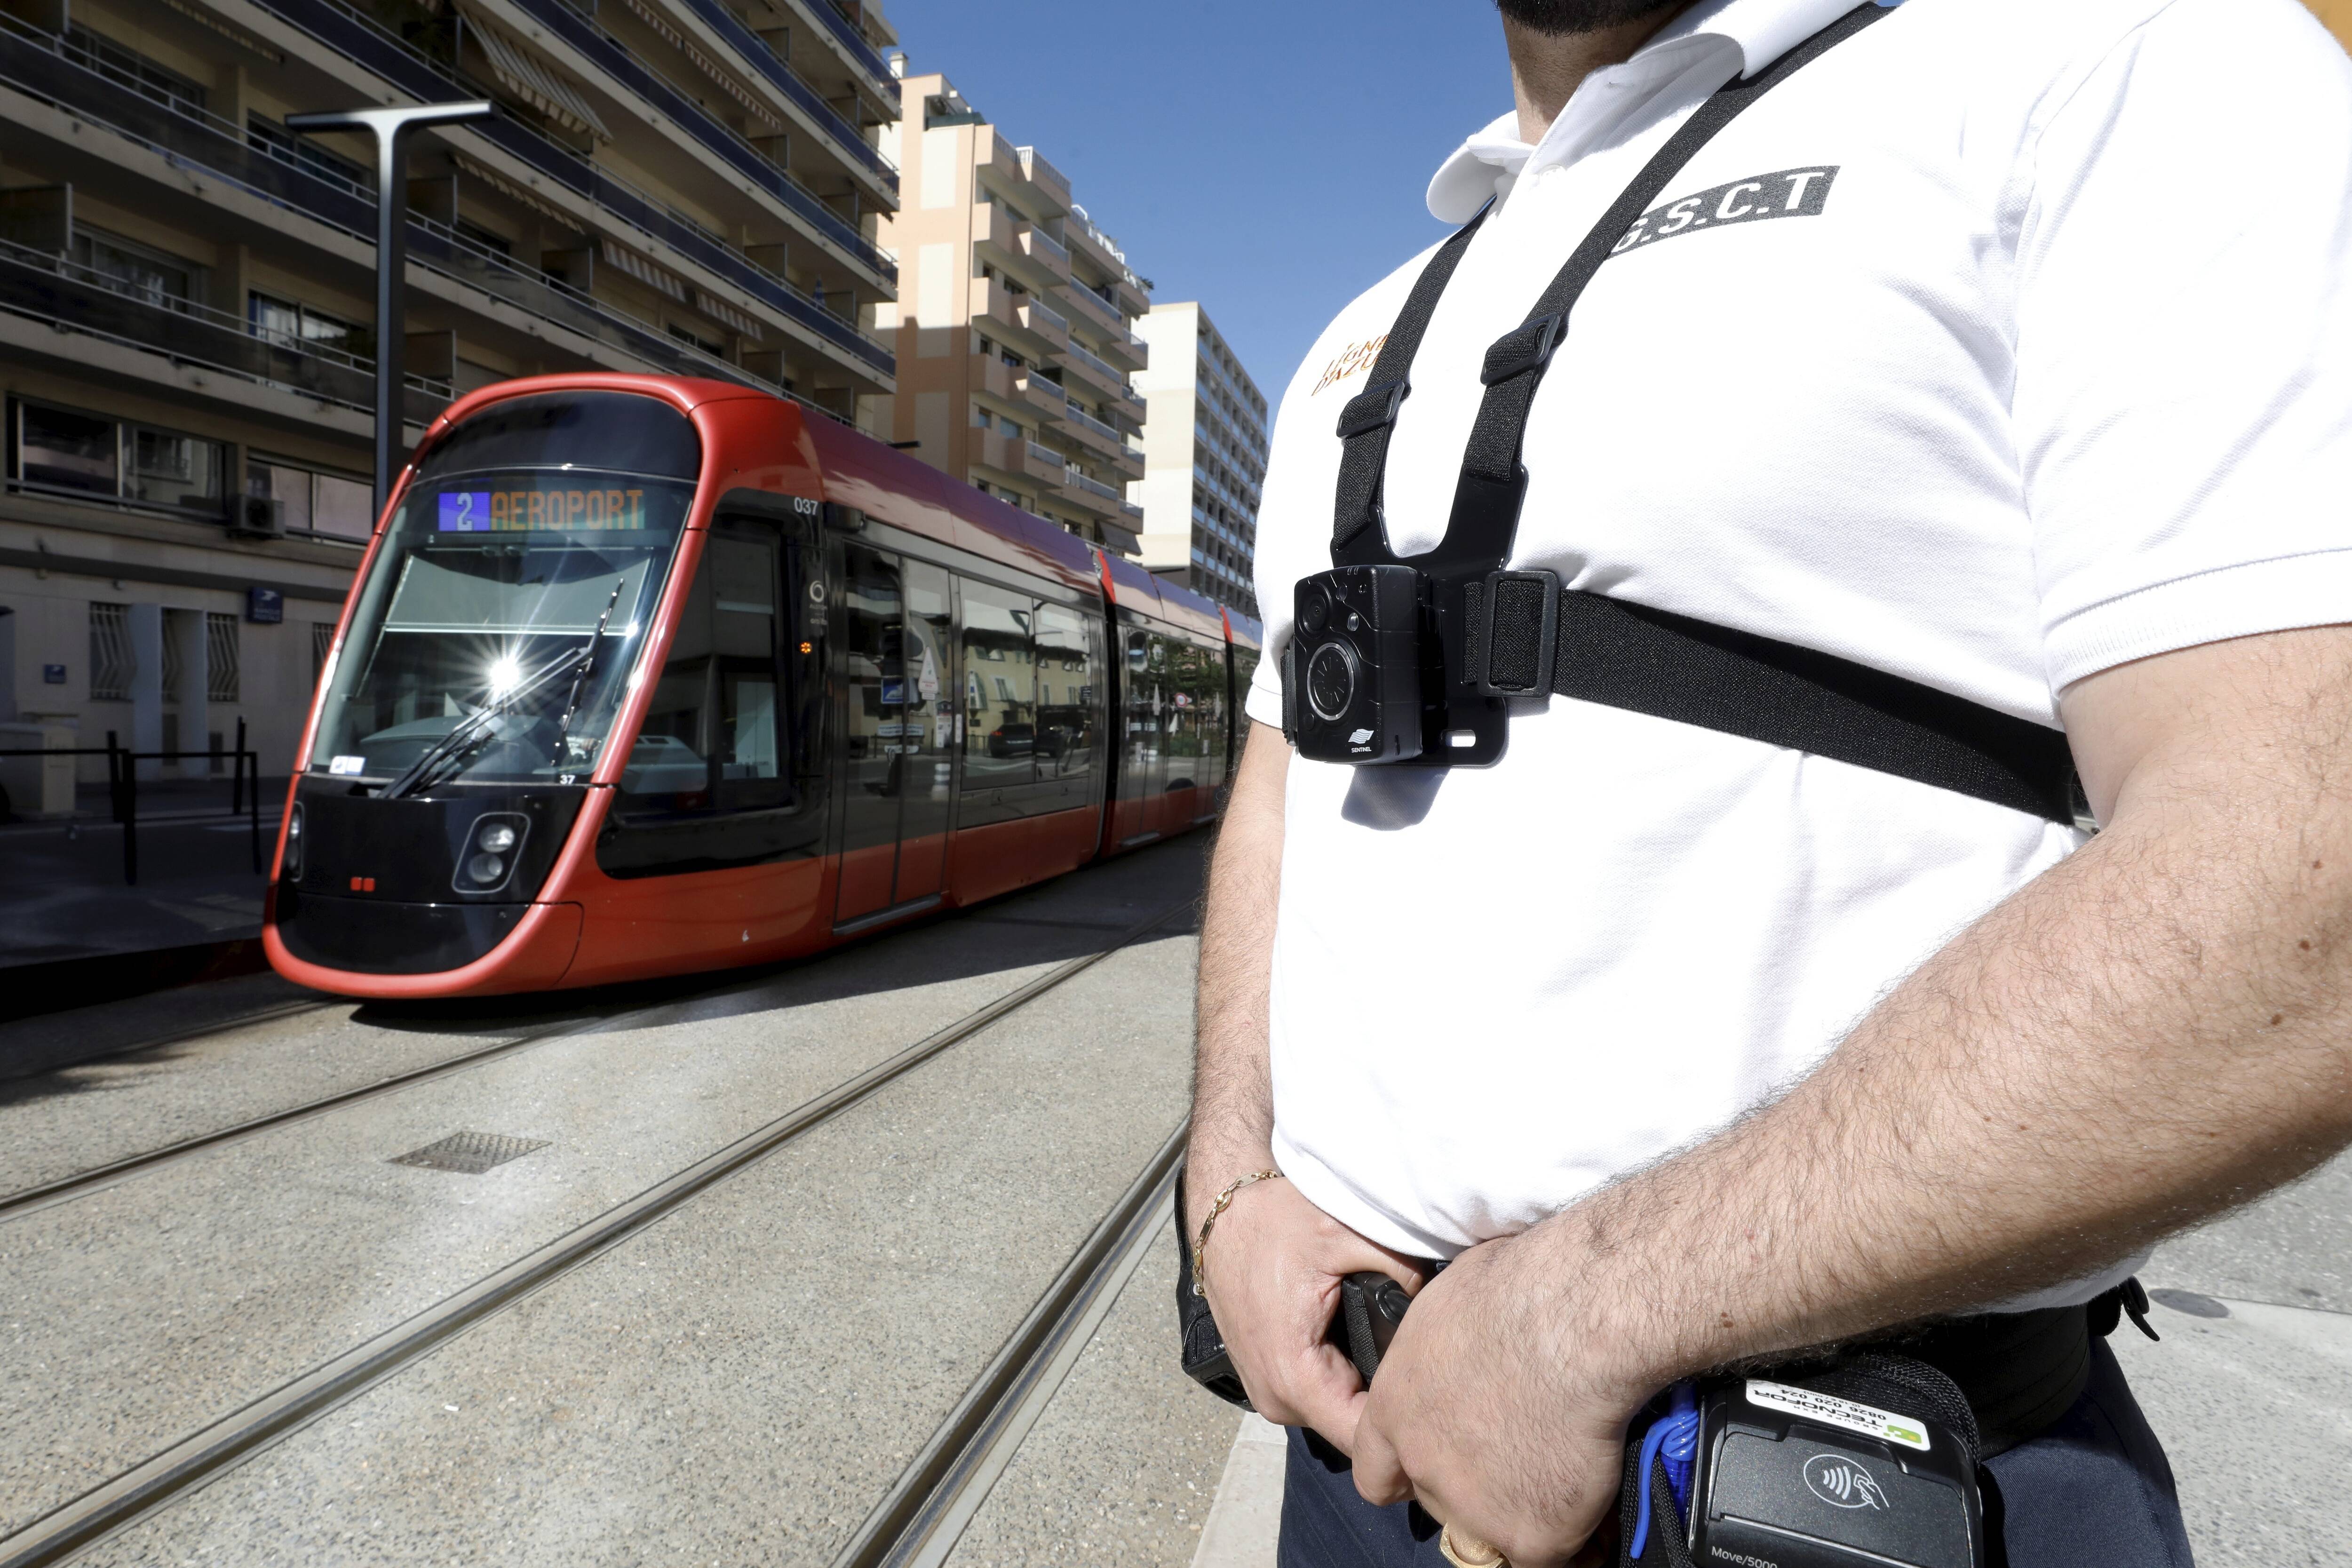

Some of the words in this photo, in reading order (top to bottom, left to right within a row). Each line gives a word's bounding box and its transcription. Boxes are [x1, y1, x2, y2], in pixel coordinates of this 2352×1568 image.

[456, 492, 473, 531] 2
[491, 489, 643, 531] AEROPORT
[794, 496, 818, 516] 037
[560, 774, 576, 785] 37
[1780, 1389, 1808, 1399] 024
[1754, 1390, 1883, 1427] TECNOFOR
[1814, 1398, 1842, 1408] 020
[1849, 1406, 1887, 1420] 0826
[1827, 1413, 1878, 1430] GROUPE
